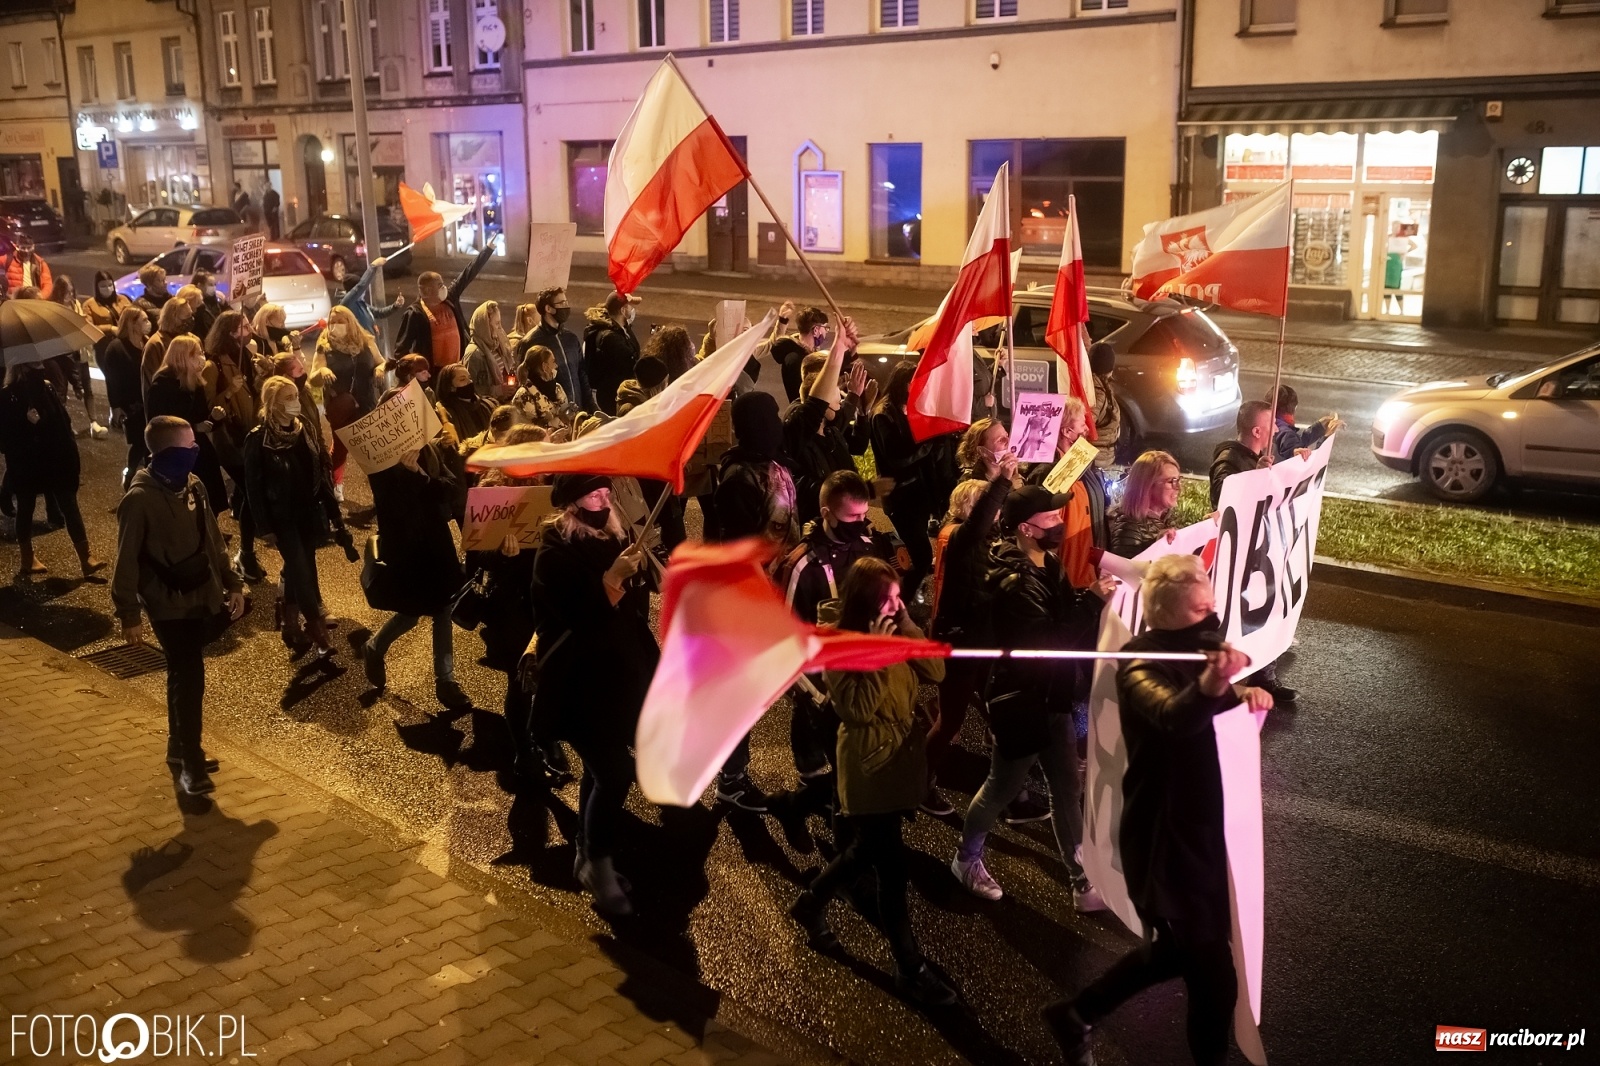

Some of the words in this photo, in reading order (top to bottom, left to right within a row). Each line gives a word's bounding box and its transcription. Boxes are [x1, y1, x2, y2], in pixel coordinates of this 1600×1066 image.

[101, 142, 114, 160] P
[375, 418, 391, 433] TAK
[393, 409, 405, 425] JAK
[470, 500, 516, 523] WYBÓR
[1193, 464, 1327, 641] OBIET
